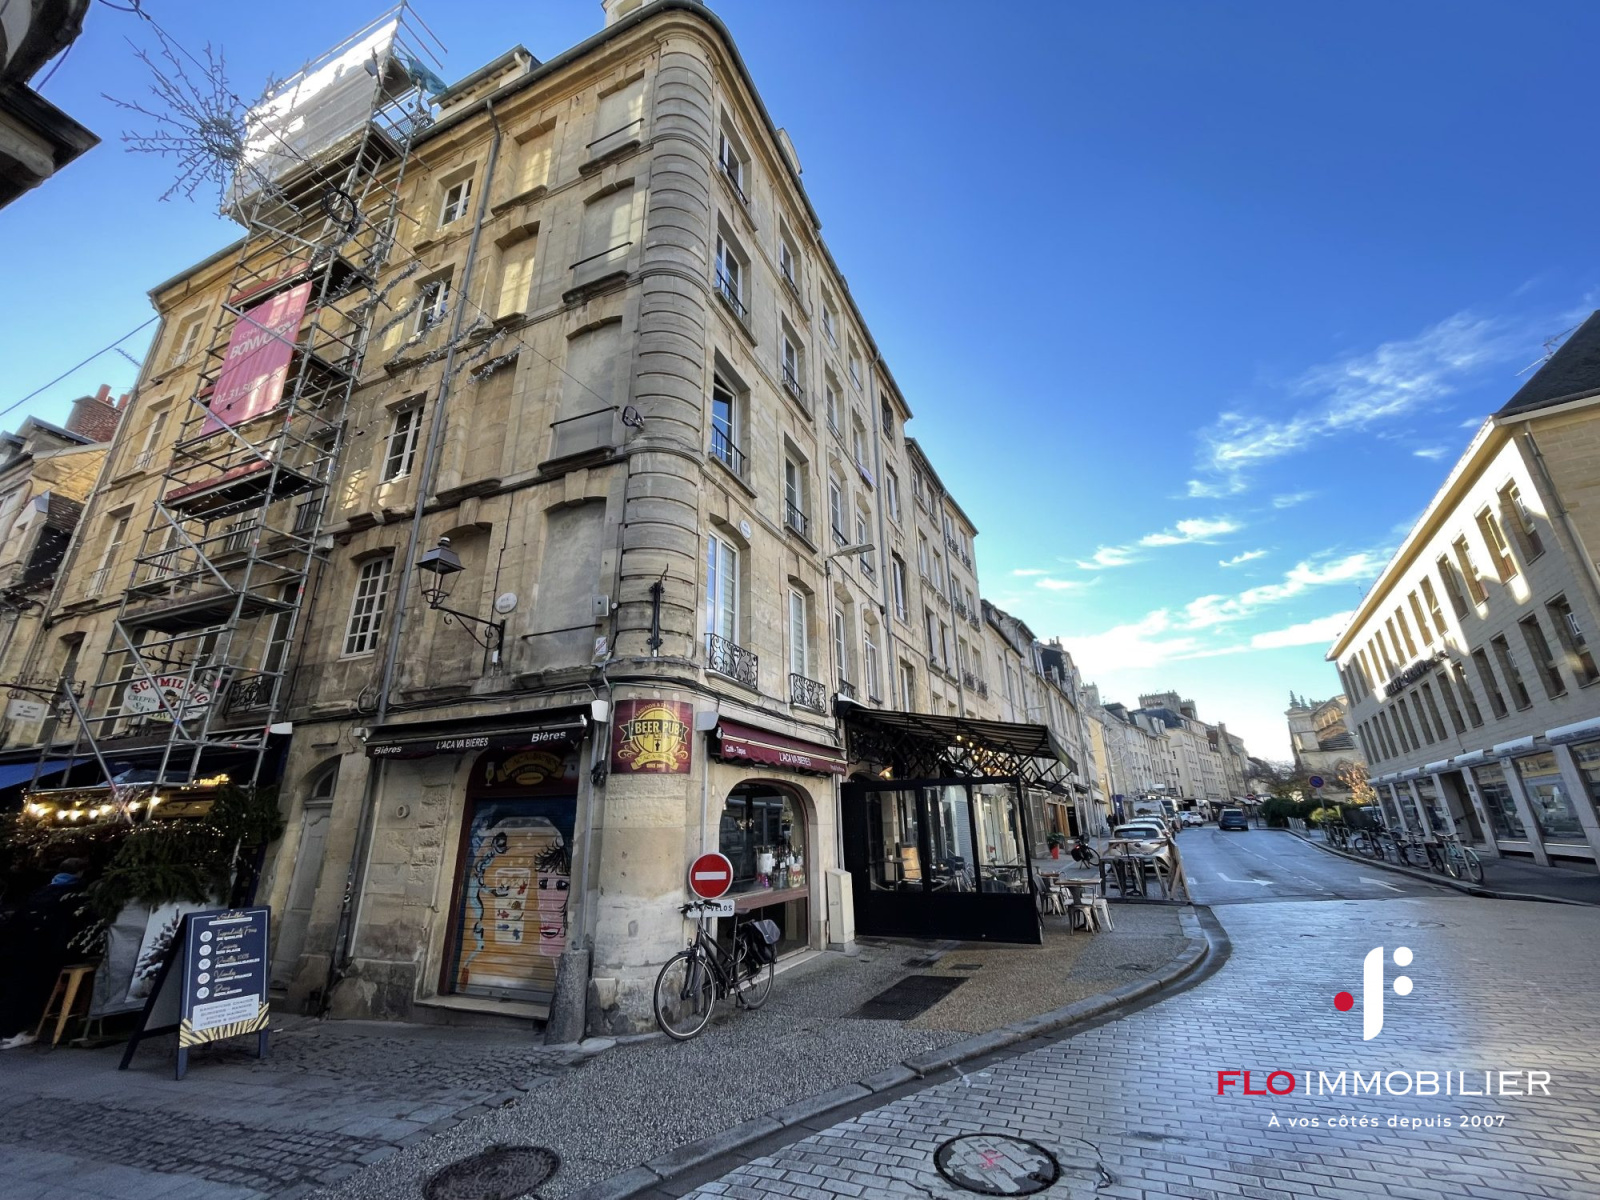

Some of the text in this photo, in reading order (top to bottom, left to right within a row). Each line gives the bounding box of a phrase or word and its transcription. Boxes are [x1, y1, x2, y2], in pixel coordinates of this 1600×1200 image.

[635, 721, 660, 735] BEER
[662, 721, 680, 735] PUB
[374, 745, 402, 755] Bières
[436, 740, 456, 750] L'ACA
[456, 739, 465, 749] VA
[531, 730, 567, 743] Bières
